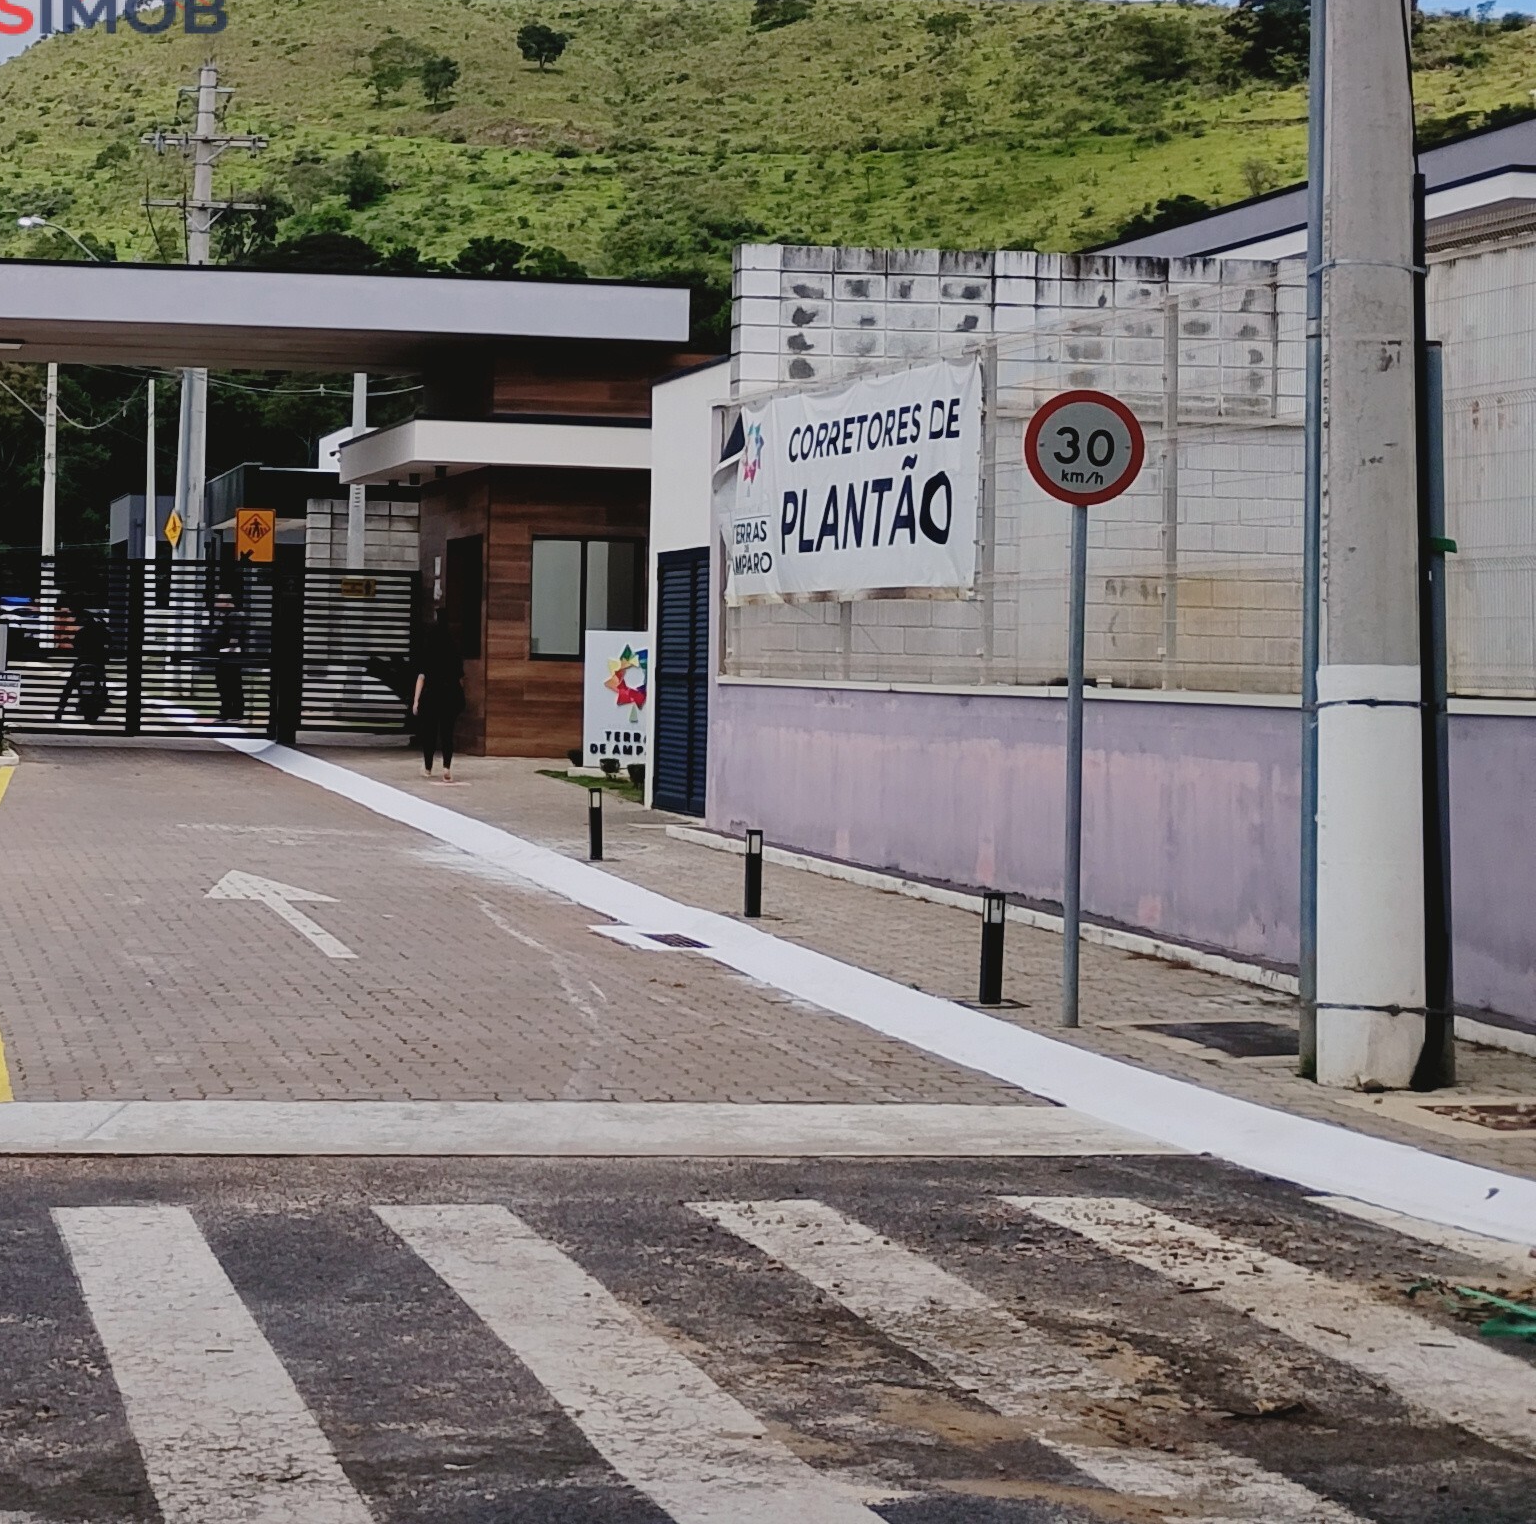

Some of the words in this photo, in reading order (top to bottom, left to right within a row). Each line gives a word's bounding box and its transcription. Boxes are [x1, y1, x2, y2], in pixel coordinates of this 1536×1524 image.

[788, 402, 922, 463] CORRETORES
[928, 397, 961, 440] DE
[1053, 426, 1115, 468] 30
[1061, 469, 1104, 486] km/h
[780, 453, 953, 556] PLANTÃO
[589, 743, 607, 755] DE
[612, 744, 647, 756] AMP
